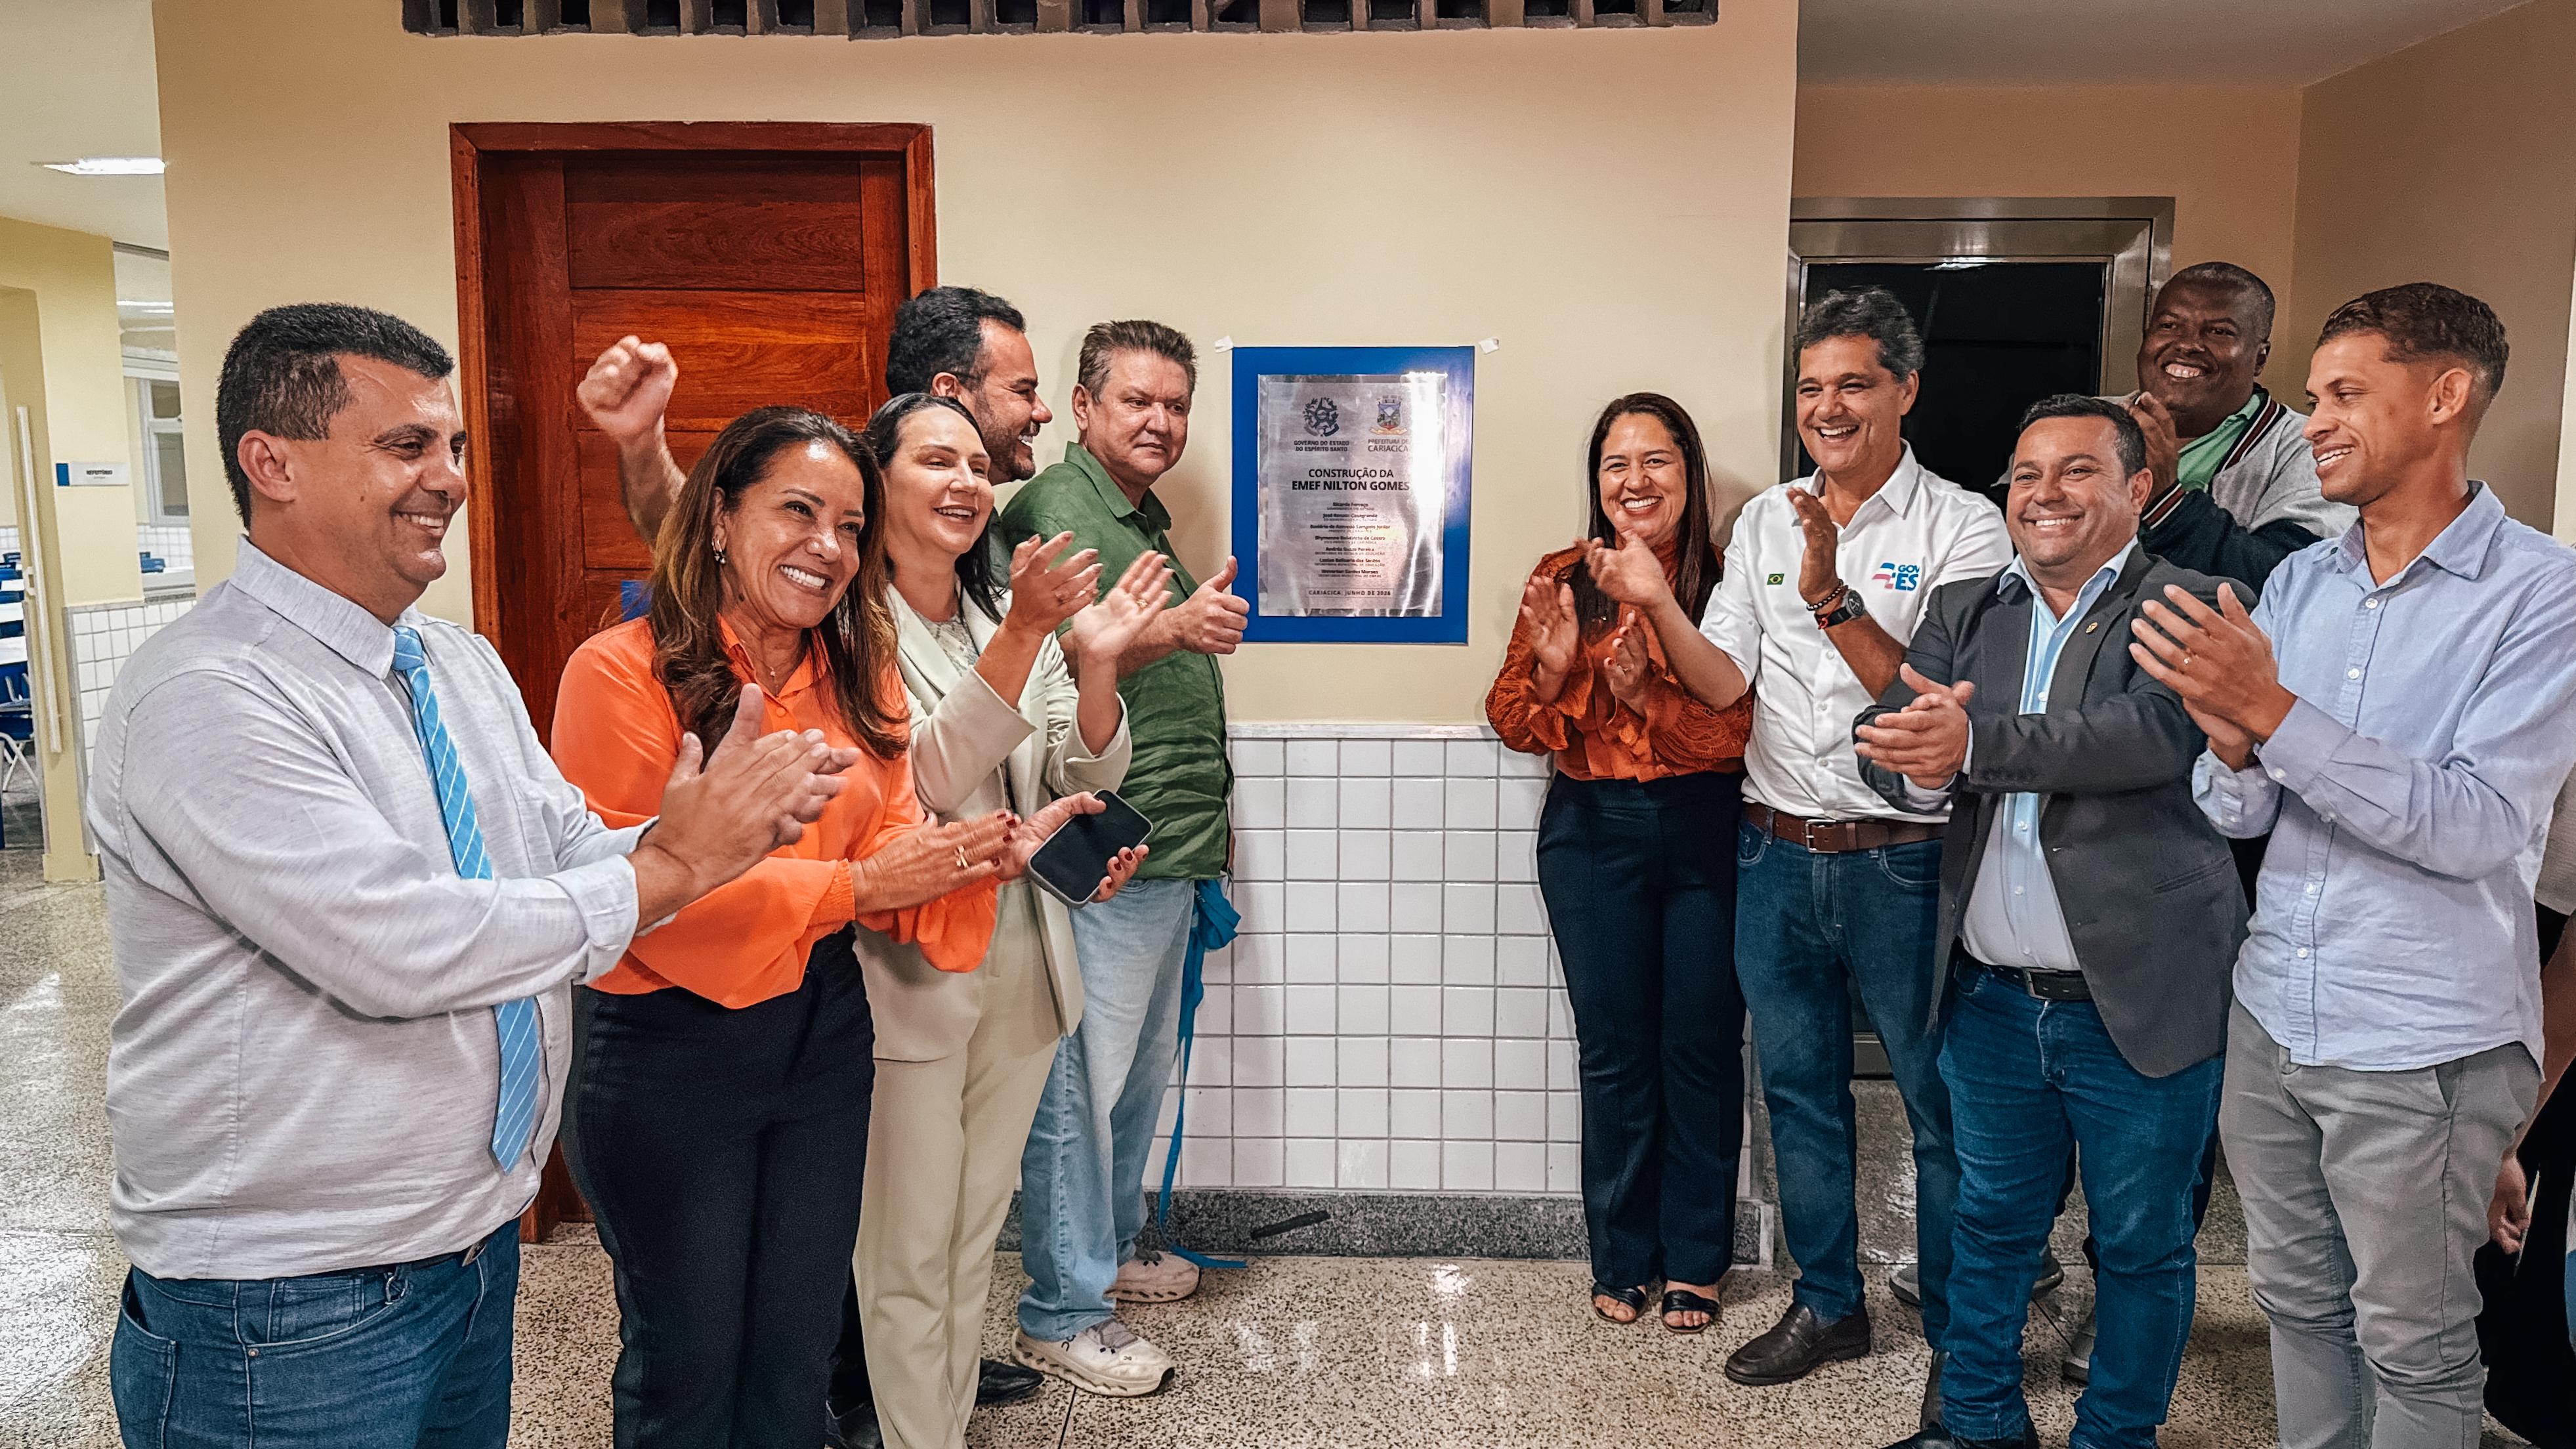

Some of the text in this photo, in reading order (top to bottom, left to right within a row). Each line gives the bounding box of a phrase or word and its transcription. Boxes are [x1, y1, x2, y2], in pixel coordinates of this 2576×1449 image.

[1309, 467, 1394, 480] CONSTRUÇÃO DA
[1292, 480, 1409, 491] EMEF NILTON GOMES
[1895, 573, 1919, 591] ES
